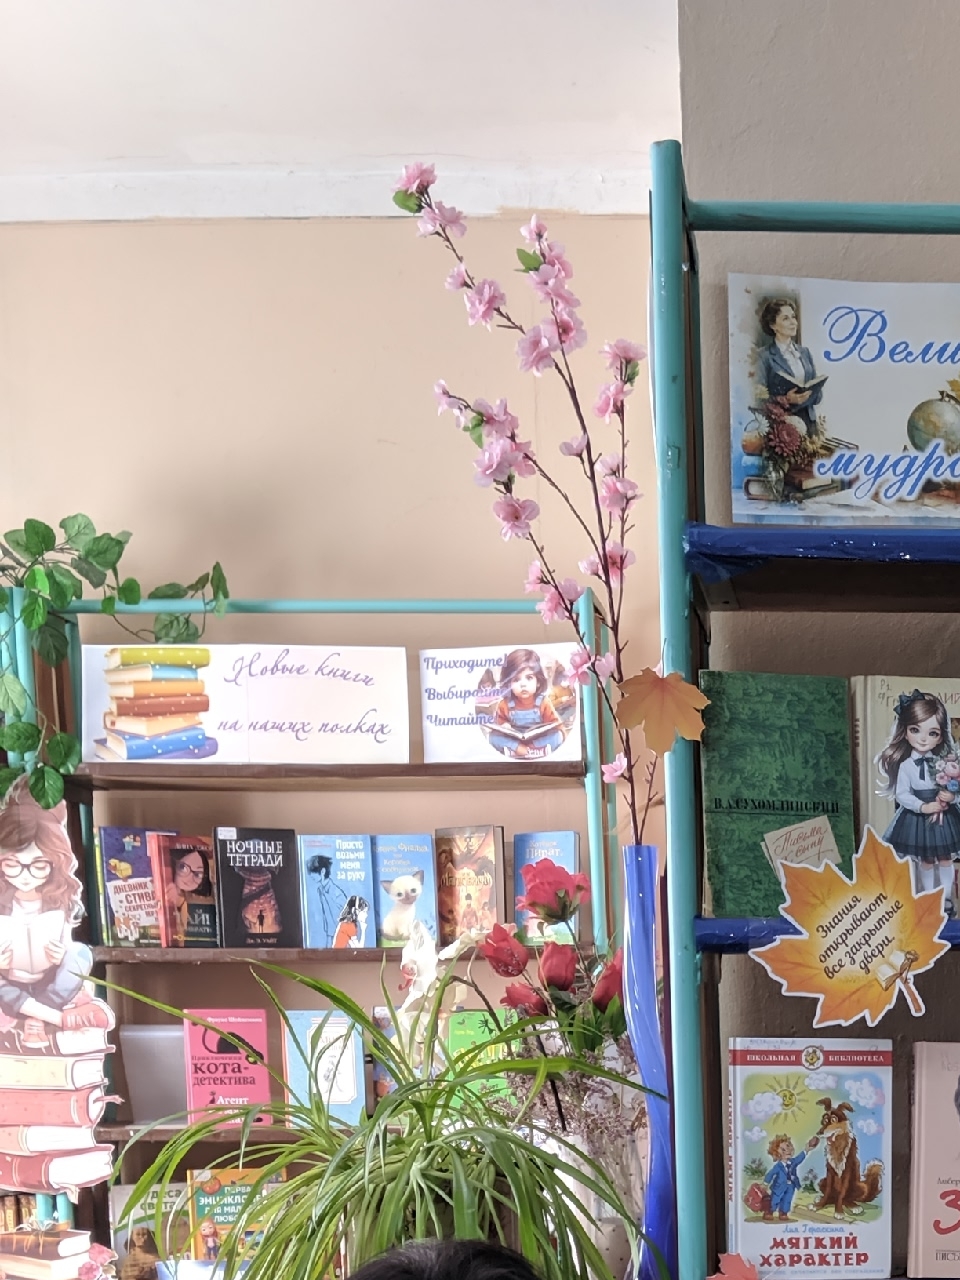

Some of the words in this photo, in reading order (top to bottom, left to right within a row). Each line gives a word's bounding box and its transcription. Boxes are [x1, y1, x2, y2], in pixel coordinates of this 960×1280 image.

[223, 652, 310, 687] Новые
[314, 652, 376, 687] книги
[216, 717, 243, 733] на
[247, 717, 313, 742] наших
[316, 708, 392, 744] полках
[226, 839, 283, 856] НОЧНЫЕ
[335, 839, 364, 851] Просто
[226, 853, 283, 868] ТЕТРАДИ
[335, 851, 367, 861] возьми
[339, 860, 361, 870] меня
[336, 870, 348, 880] за
[348, 872, 366, 881] руку
[113, 882, 149, 896] ДНЕВНИК
[815, 894, 863, 939] Знания
[817, 892, 889, 964] открывают
[823, 958, 846, 980] все
[844, 899, 904, 966] закрытые
[858, 936, 896, 974] двери.
[747, 1053, 797, 1063] ШКОЛЬНАЯ
[828, 1054, 885, 1063] БИБЛИОТЕКА
[192, 1074, 256, 1087] детектива
[216, 1095, 249, 1106] Агент
